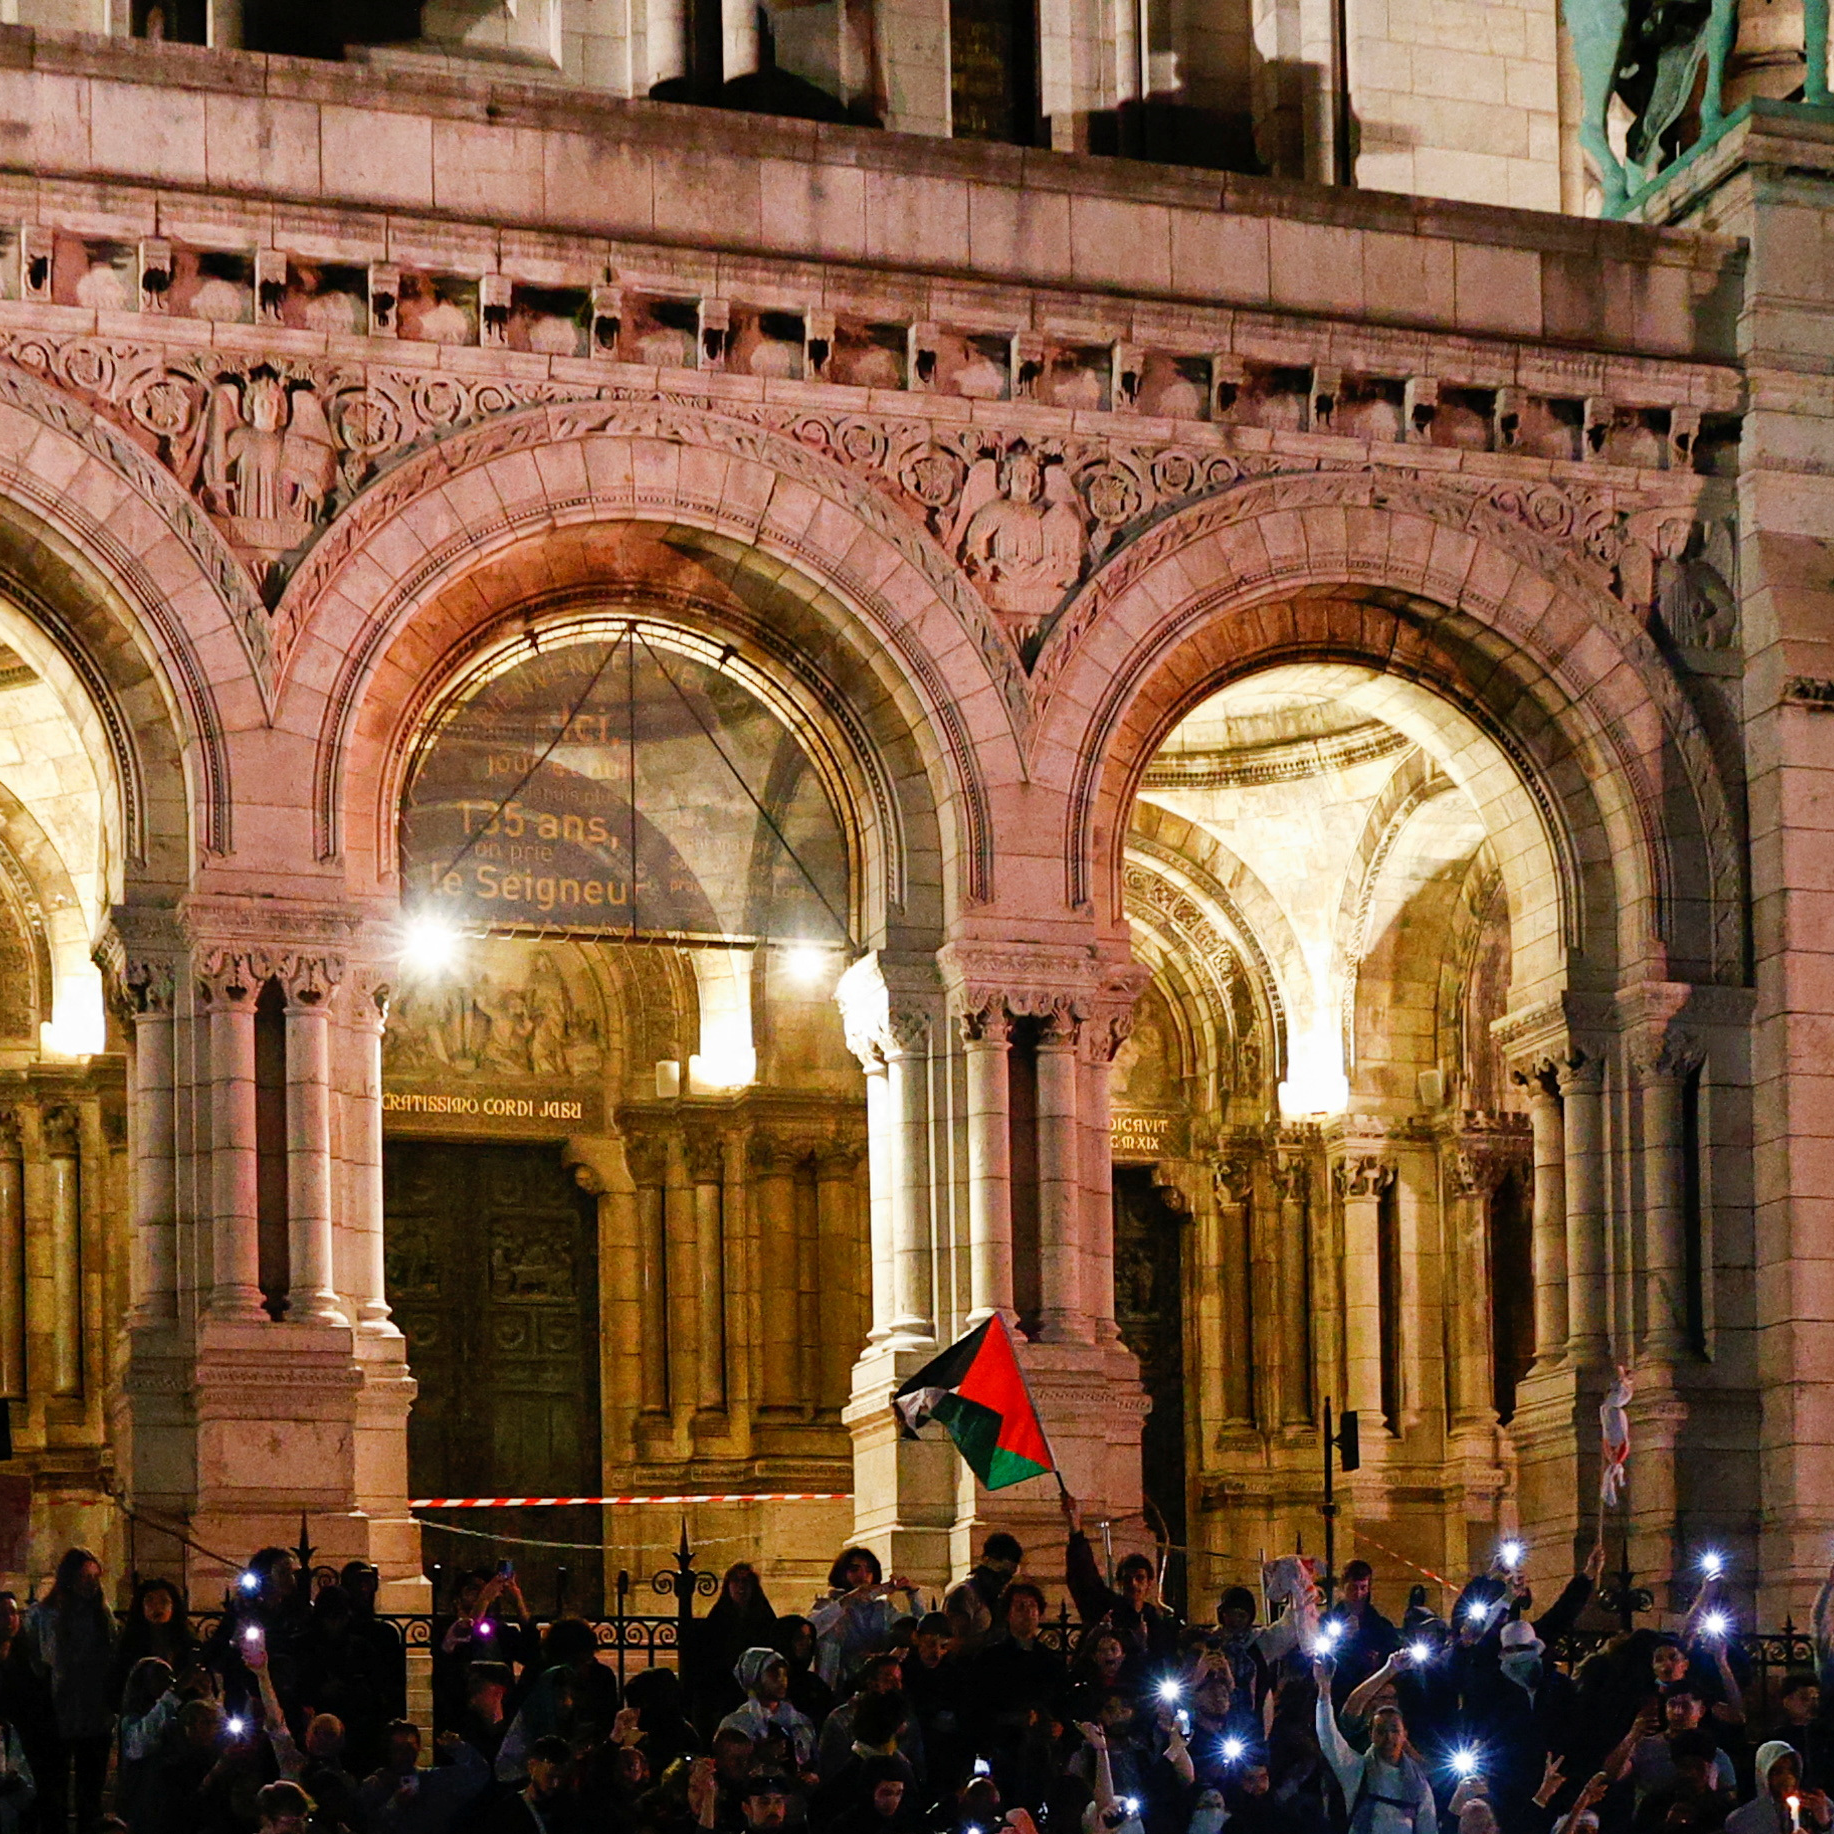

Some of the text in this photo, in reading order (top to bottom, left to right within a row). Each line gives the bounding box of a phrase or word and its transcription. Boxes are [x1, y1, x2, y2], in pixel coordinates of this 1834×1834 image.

[537, 812, 619, 849] ans,
[474, 841, 553, 864] on prie
[483, 1097, 534, 1117] CORDI
[539, 1100, 582, 1119] JESU
